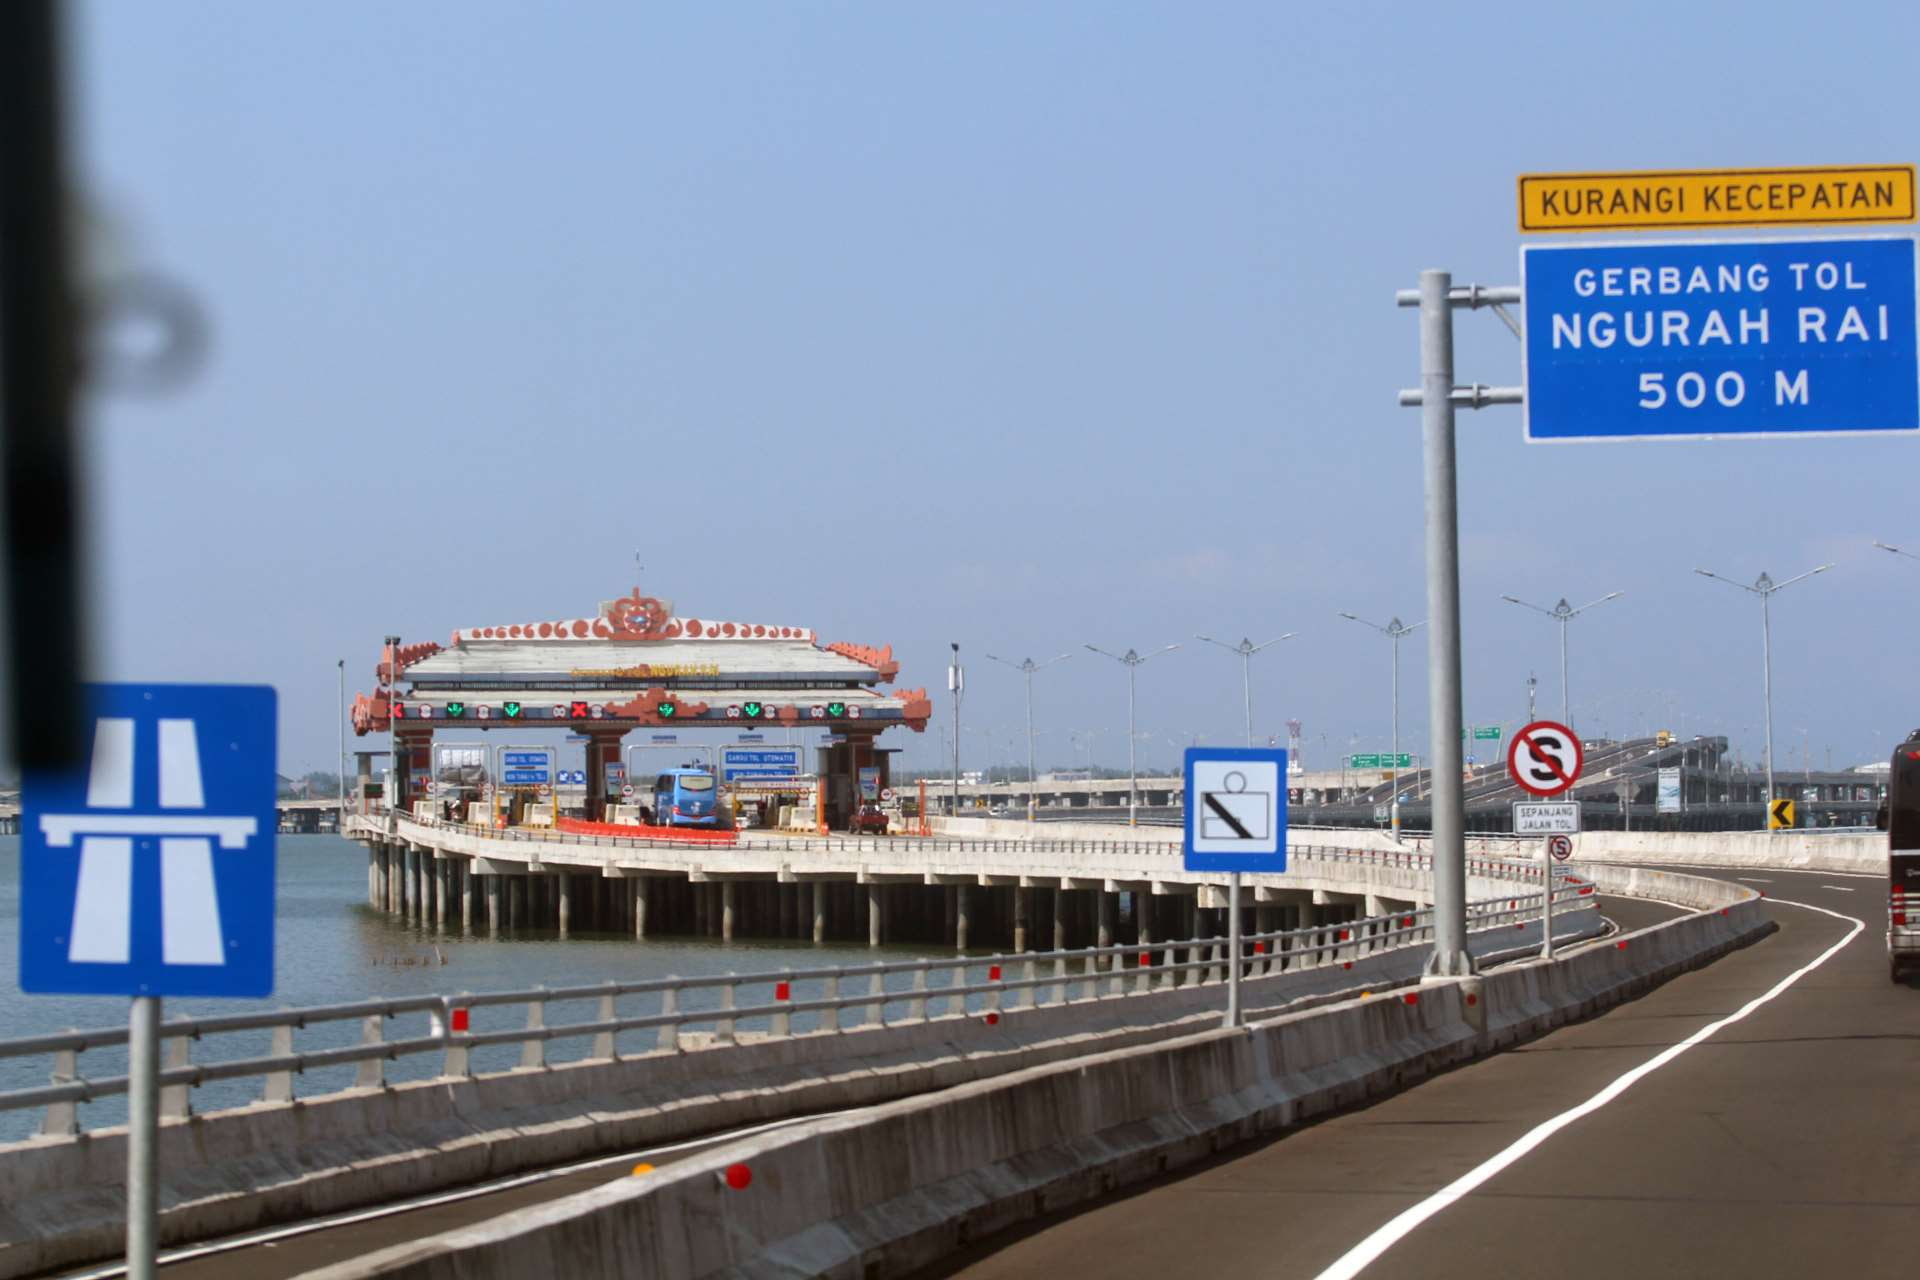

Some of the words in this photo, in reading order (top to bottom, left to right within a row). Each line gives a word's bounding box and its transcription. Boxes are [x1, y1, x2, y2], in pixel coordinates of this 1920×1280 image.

[1541, 187, 1685, 216] KURANGI
[1703, 181, 1894, 212] KECEPATAN
[1573, 264, 1769, 296] GERBANG
[1788, 262, 1867, 291] TOL
[1552, 308, 1769, 349] NGURAH
[1797, 305, 1889, 343] RAI
[1638, 371, 1746, 409] 500
[1774, 369, 1809, 405] M
[1529, 736, 1563, 781] S
[1520, 807, 1573, 817] SEPANJANG
[1522, 820, 1552, 830] JALAN
[1555, 819, 1572, 829] TOL
